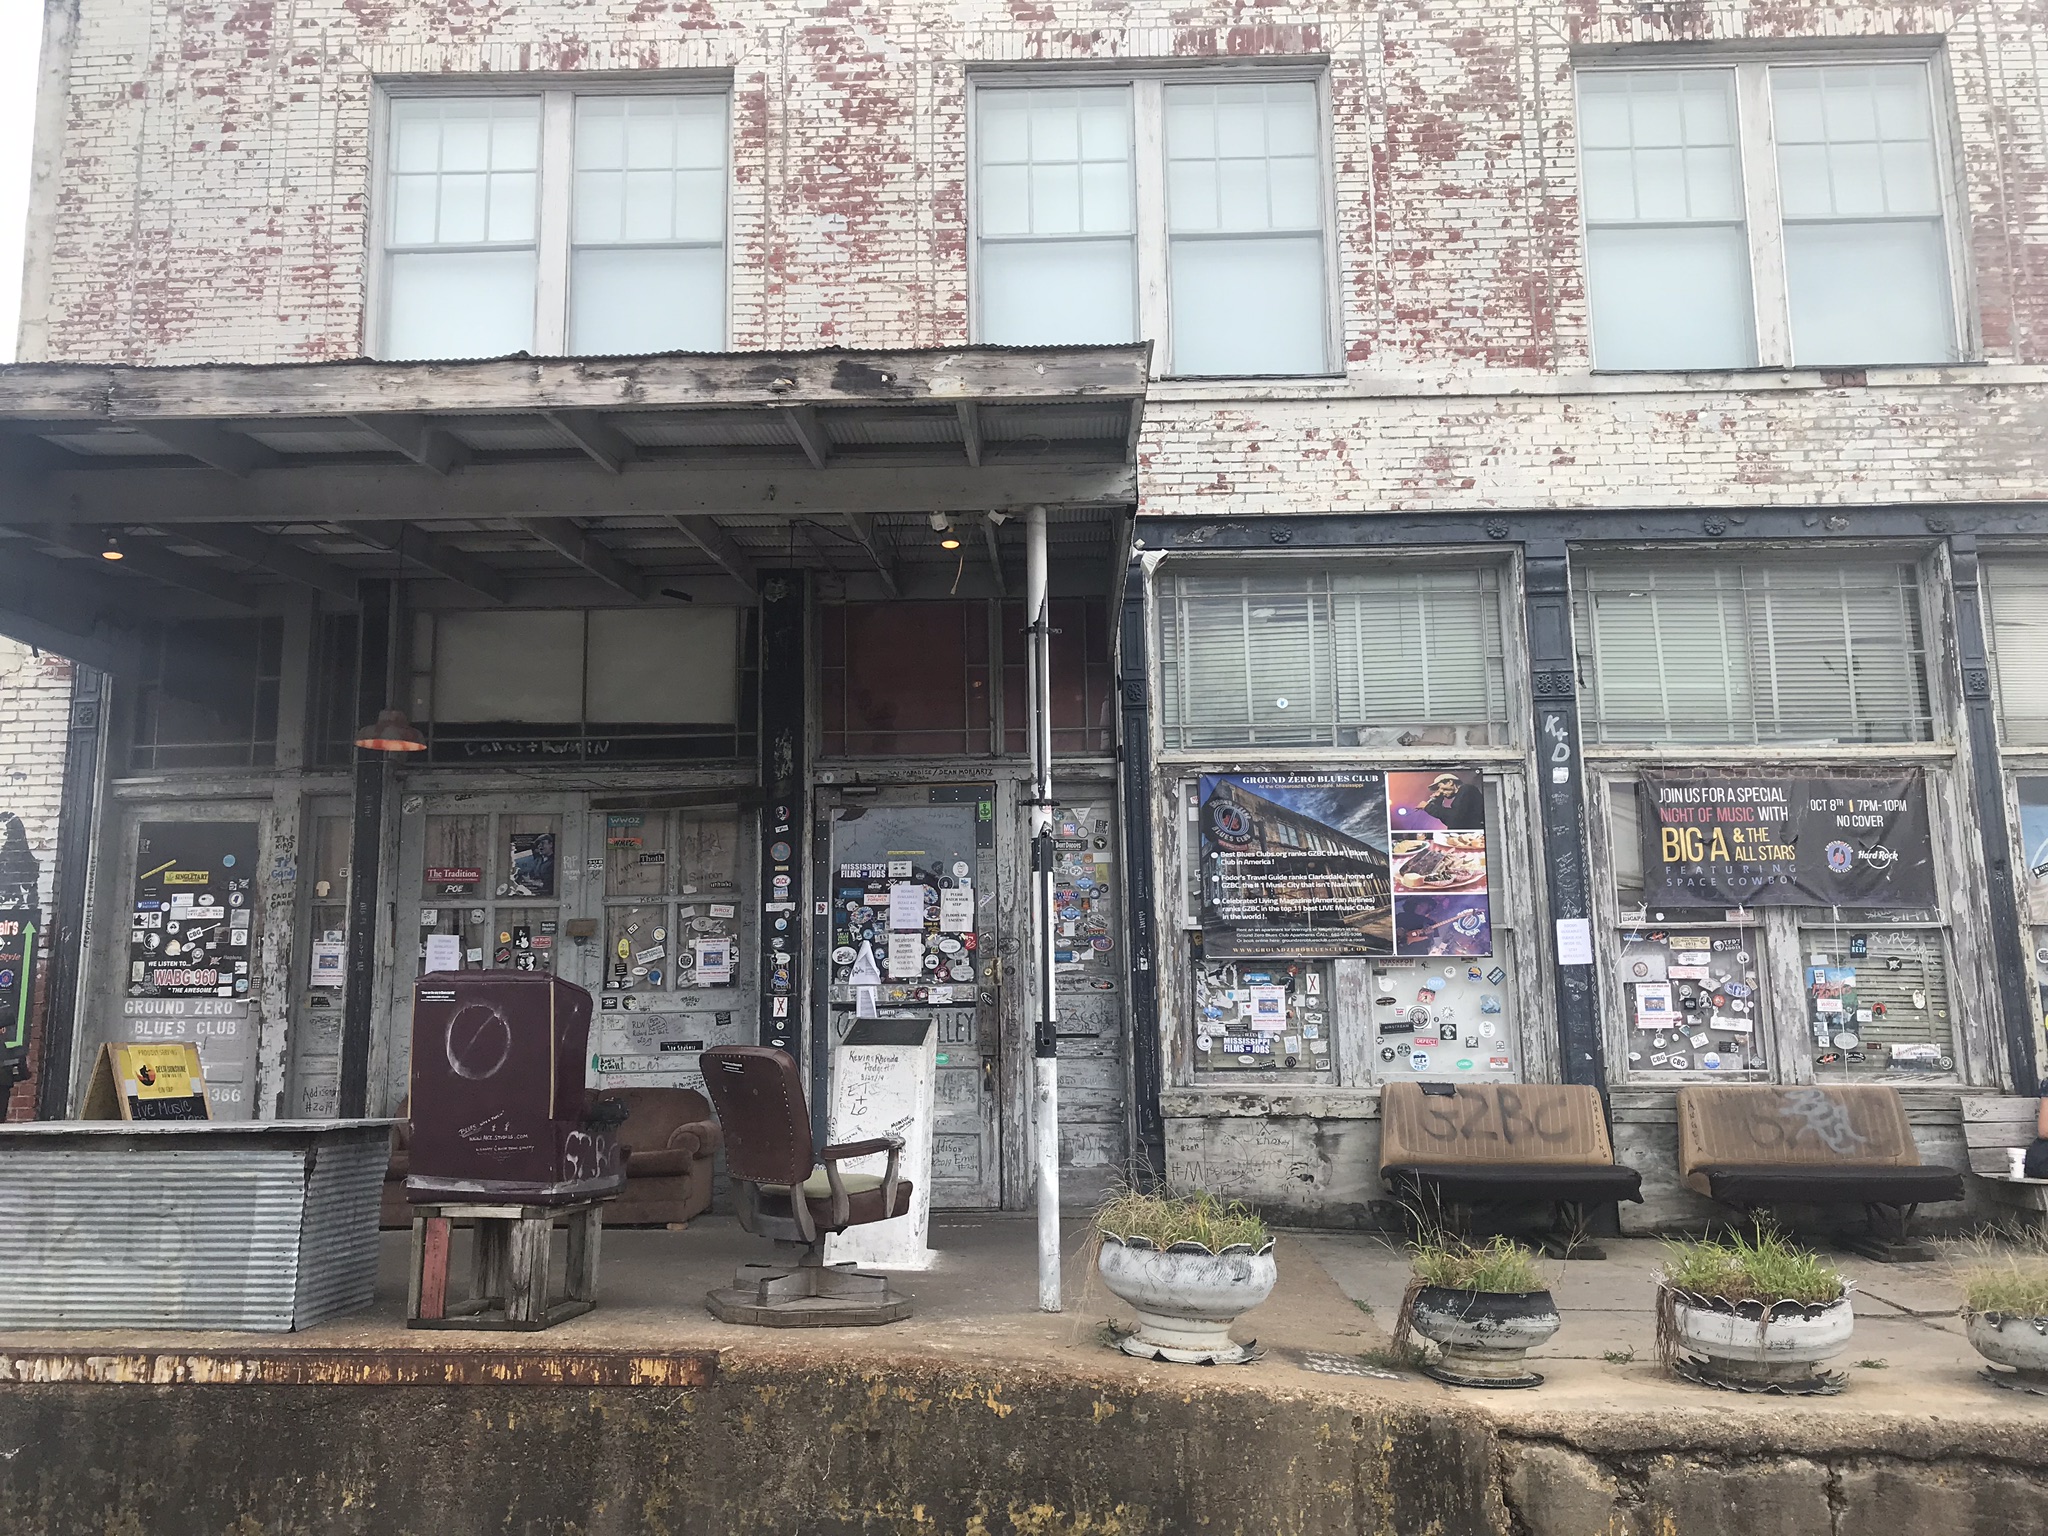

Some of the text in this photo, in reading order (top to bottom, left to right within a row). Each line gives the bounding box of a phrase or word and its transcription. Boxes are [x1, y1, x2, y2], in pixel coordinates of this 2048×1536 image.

[1318, 775, 1350, 783] BLUES
[1658, 787, 1787, 803] JOIN US FOR A SPECIAL
[1810, 799, 1827, 812] OCT
[1857, 799, 1907, 812] 7PM-10PM
[1660, 806, 1789, 823] NIGHT OF MUSIC WITH
[1836, 815, 1884, 828] NO COVER
[1733, 827, 1770, 843] & THE
[1662, 827, 1730, 863] BIG A
[1735, 845, 1796, 861] ALL STARS
[1858, 850, 1899, 861] Hard Rock
[428, 870, 478, 878] The Tradition.
[1666, 864, 1796, 875] FEATURING
[1667, 875, 1798, 887] SPACE COWBOY
[445, 884, 464, 893] POE
[189, 930, 202, 938] CBG
[154, 968, 218, 986] WABG 960
[124, 1001, 233, 1014] GROUND ZERO
[135, 1021, 236, 1035] BLUES CLUB
[1223, 1037, 1270, 1045] MISSISSIPPI
[1224, 1045, 1245, 1053] FILMS
[1252, 1045, 1270, 1053] JOBS
[1652, 1055, 1666, 1063] CBG
[1673, 1058, 1686, 1067] CBG
[208, 1089, 241, 1102] 366
[131, 1103, 156, 1119] Live
[159, 1101, 192, 1116] Music
